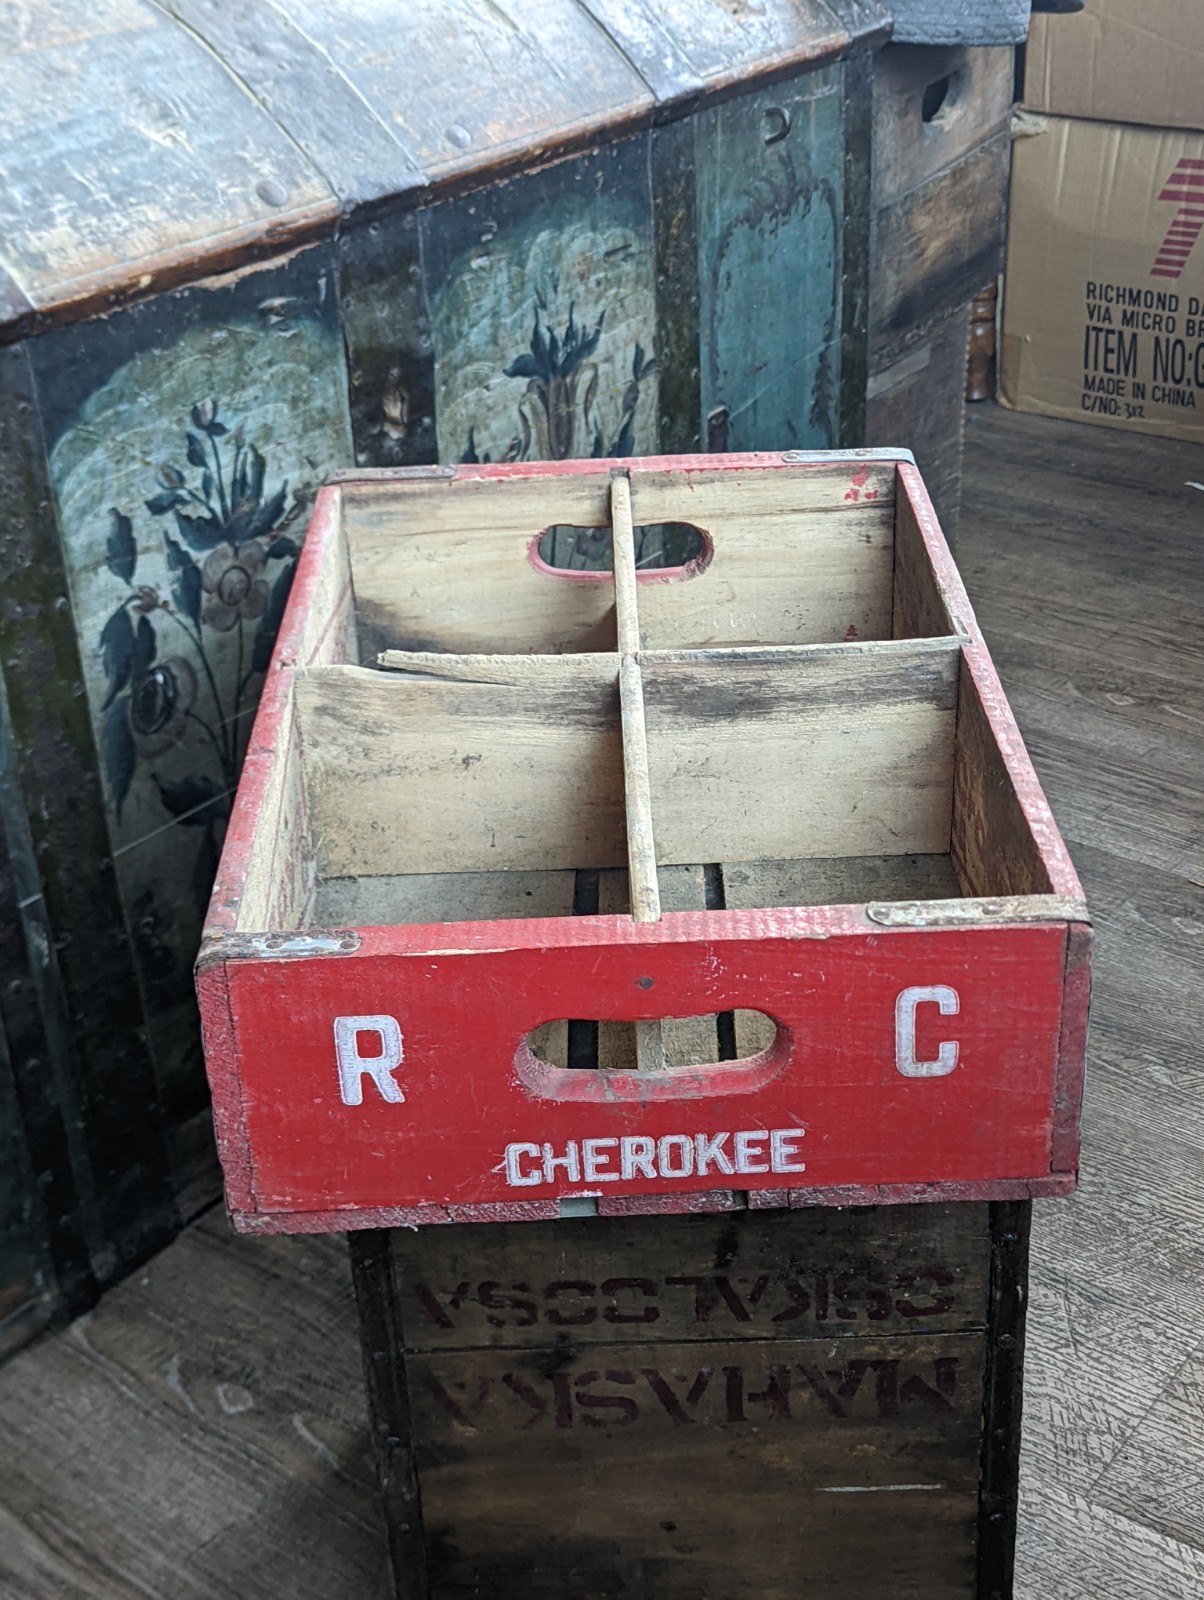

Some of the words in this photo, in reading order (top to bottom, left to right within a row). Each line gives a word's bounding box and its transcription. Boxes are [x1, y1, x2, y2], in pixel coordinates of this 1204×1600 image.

[1086, 282, 1179, 312] RICHMOND
[1086, 303, 1112, 325] VIA
[1121, 309, 1176, 334] MICRO
[1084, 325, 1138, 378] ITEM
[1081, 394, 1121, 417] C/NO:
[1083, 374, 1125, 397] MADE
[1132, 382, 1146, 400] IN
[1152, 385, 1196, 408] CHINA
[334, 1014, 405, 1106] R
[894, 984, 961, 1078] C
[505, 1127, 806, 1187] CHEROKEE
[421, 1356, 959, 1430] MAHASKA
